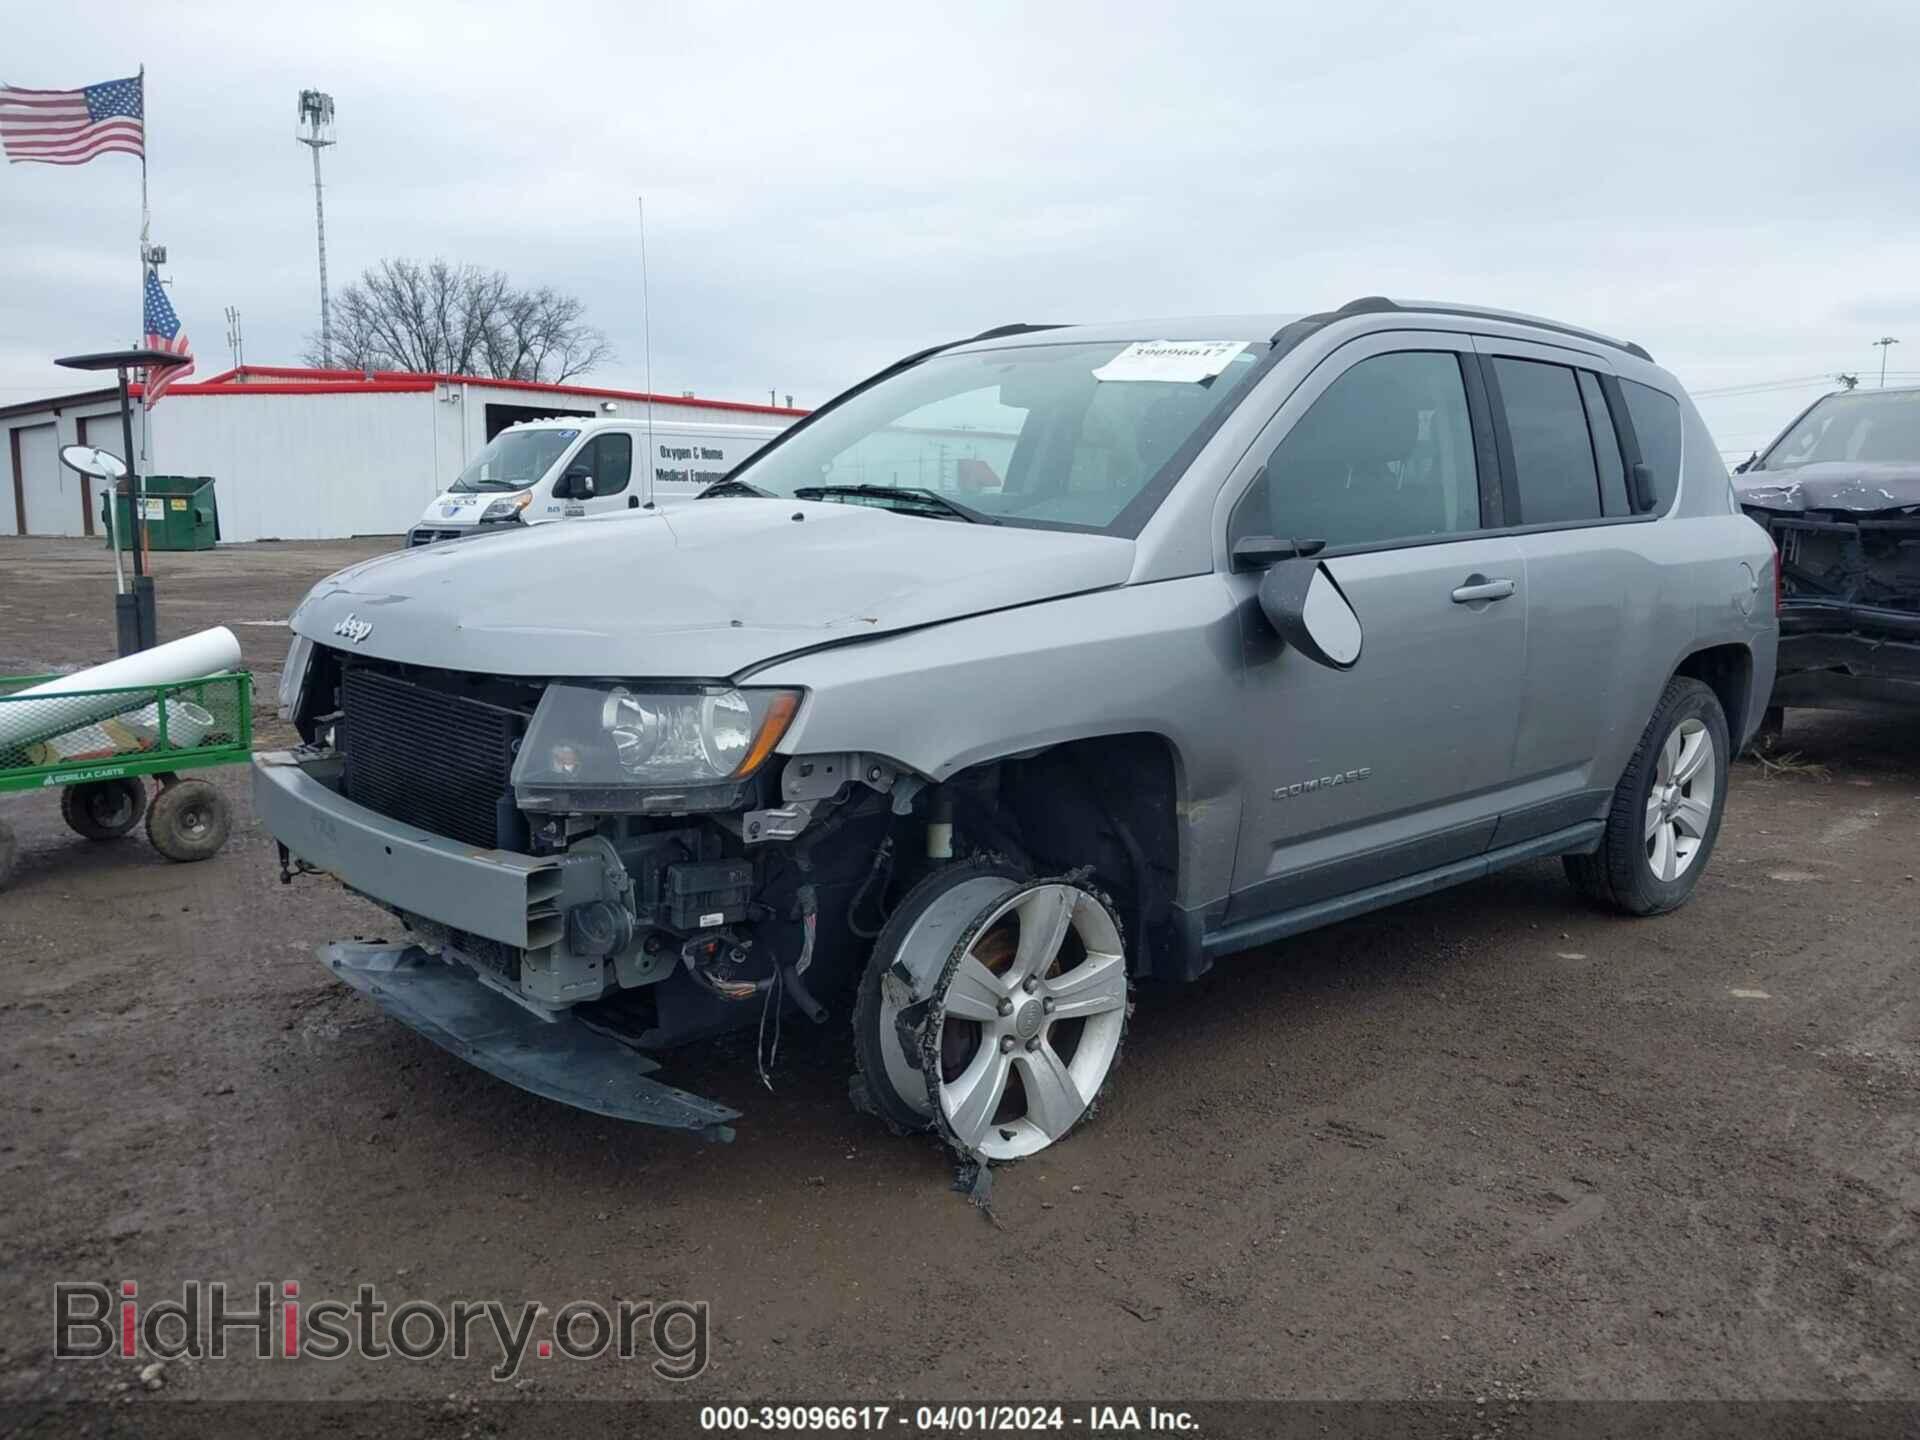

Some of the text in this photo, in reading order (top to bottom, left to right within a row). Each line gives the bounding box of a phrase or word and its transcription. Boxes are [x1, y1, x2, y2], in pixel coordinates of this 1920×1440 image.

[660, 445, 691, 460] Oxygen
[701, 447, 723, 460] Home
[656, 468, 688, 481] Medical
[334, 612, 373, 644] Jeep
[54, 767, 124, 783] GORILLA CARTS
[1273, 767, 1371, 800] COMPASS
